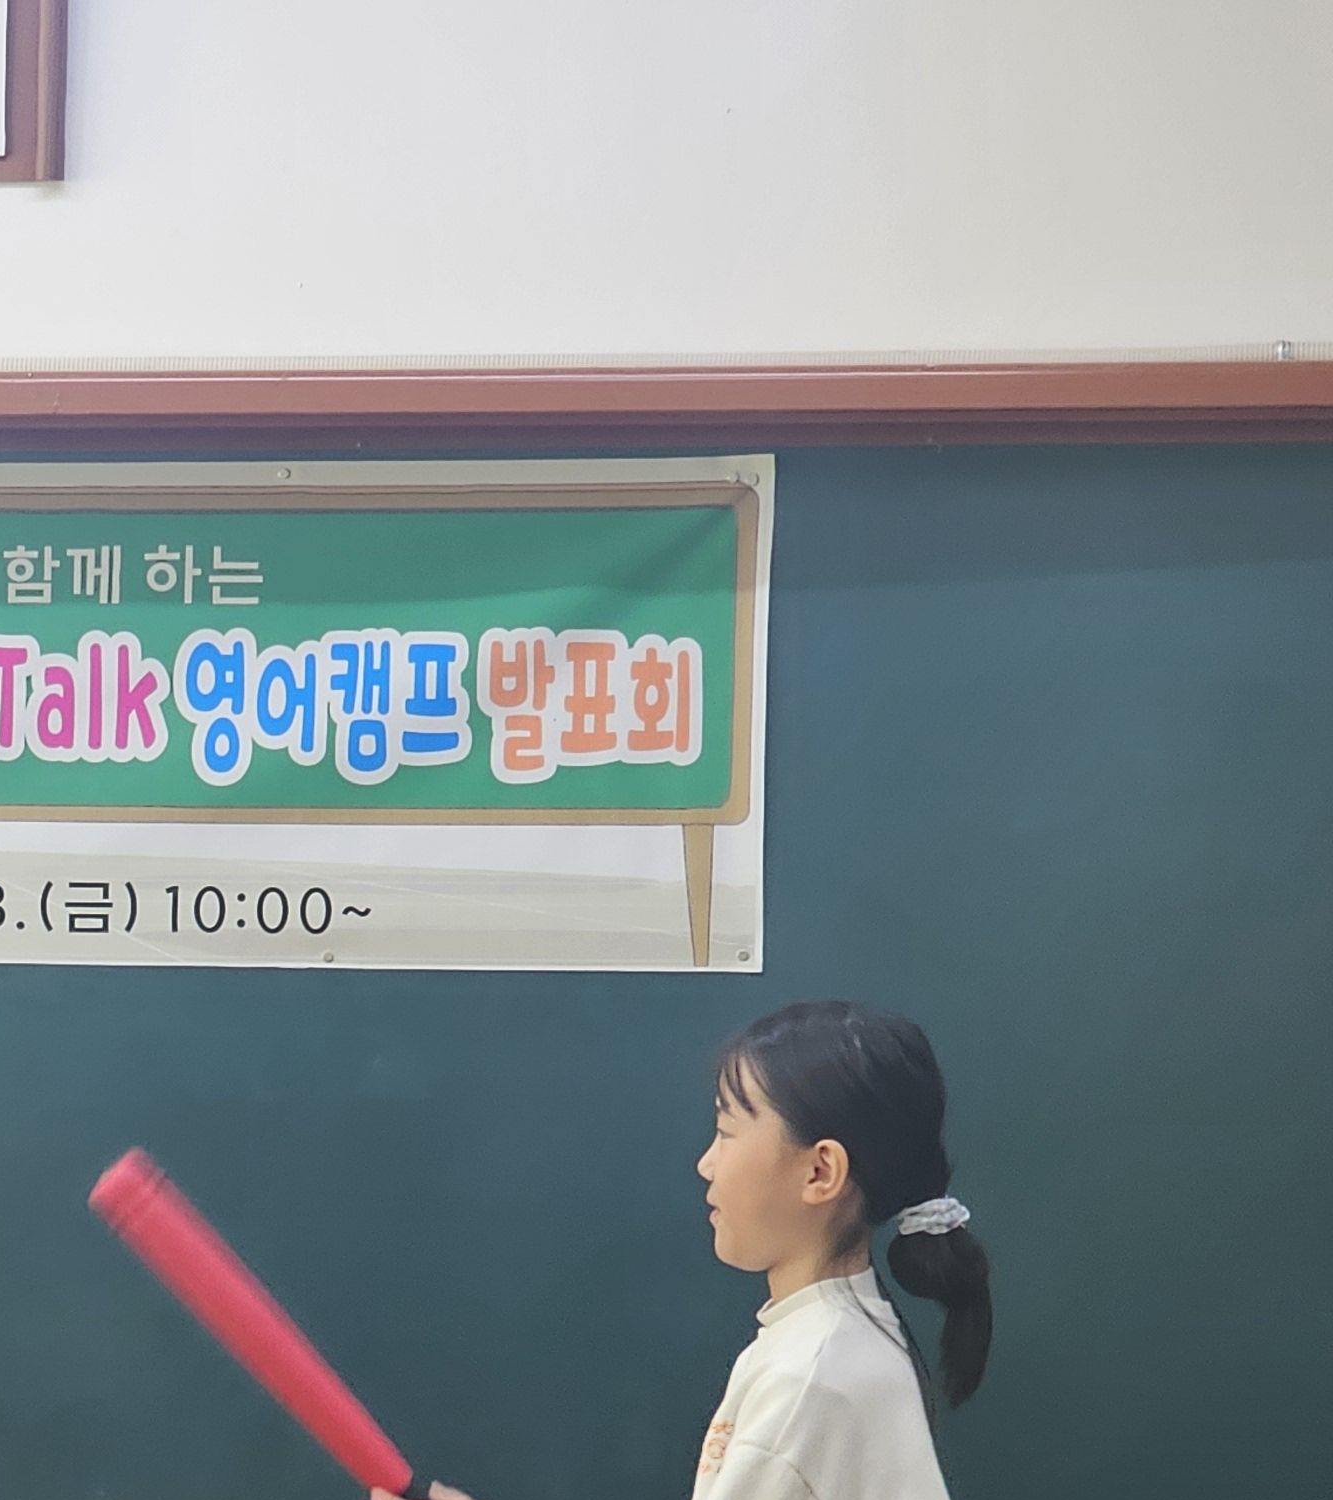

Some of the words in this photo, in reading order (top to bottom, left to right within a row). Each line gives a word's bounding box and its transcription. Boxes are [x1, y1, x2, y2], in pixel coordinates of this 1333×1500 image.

[2, 544, 122, 605] 함께
[143, 544, 264, 605] 하는
[185, 640, 461, 774] 영어캠프
[489, 638, 691, 772] 발표회
[165, 884, 373, 935] 10:00~
